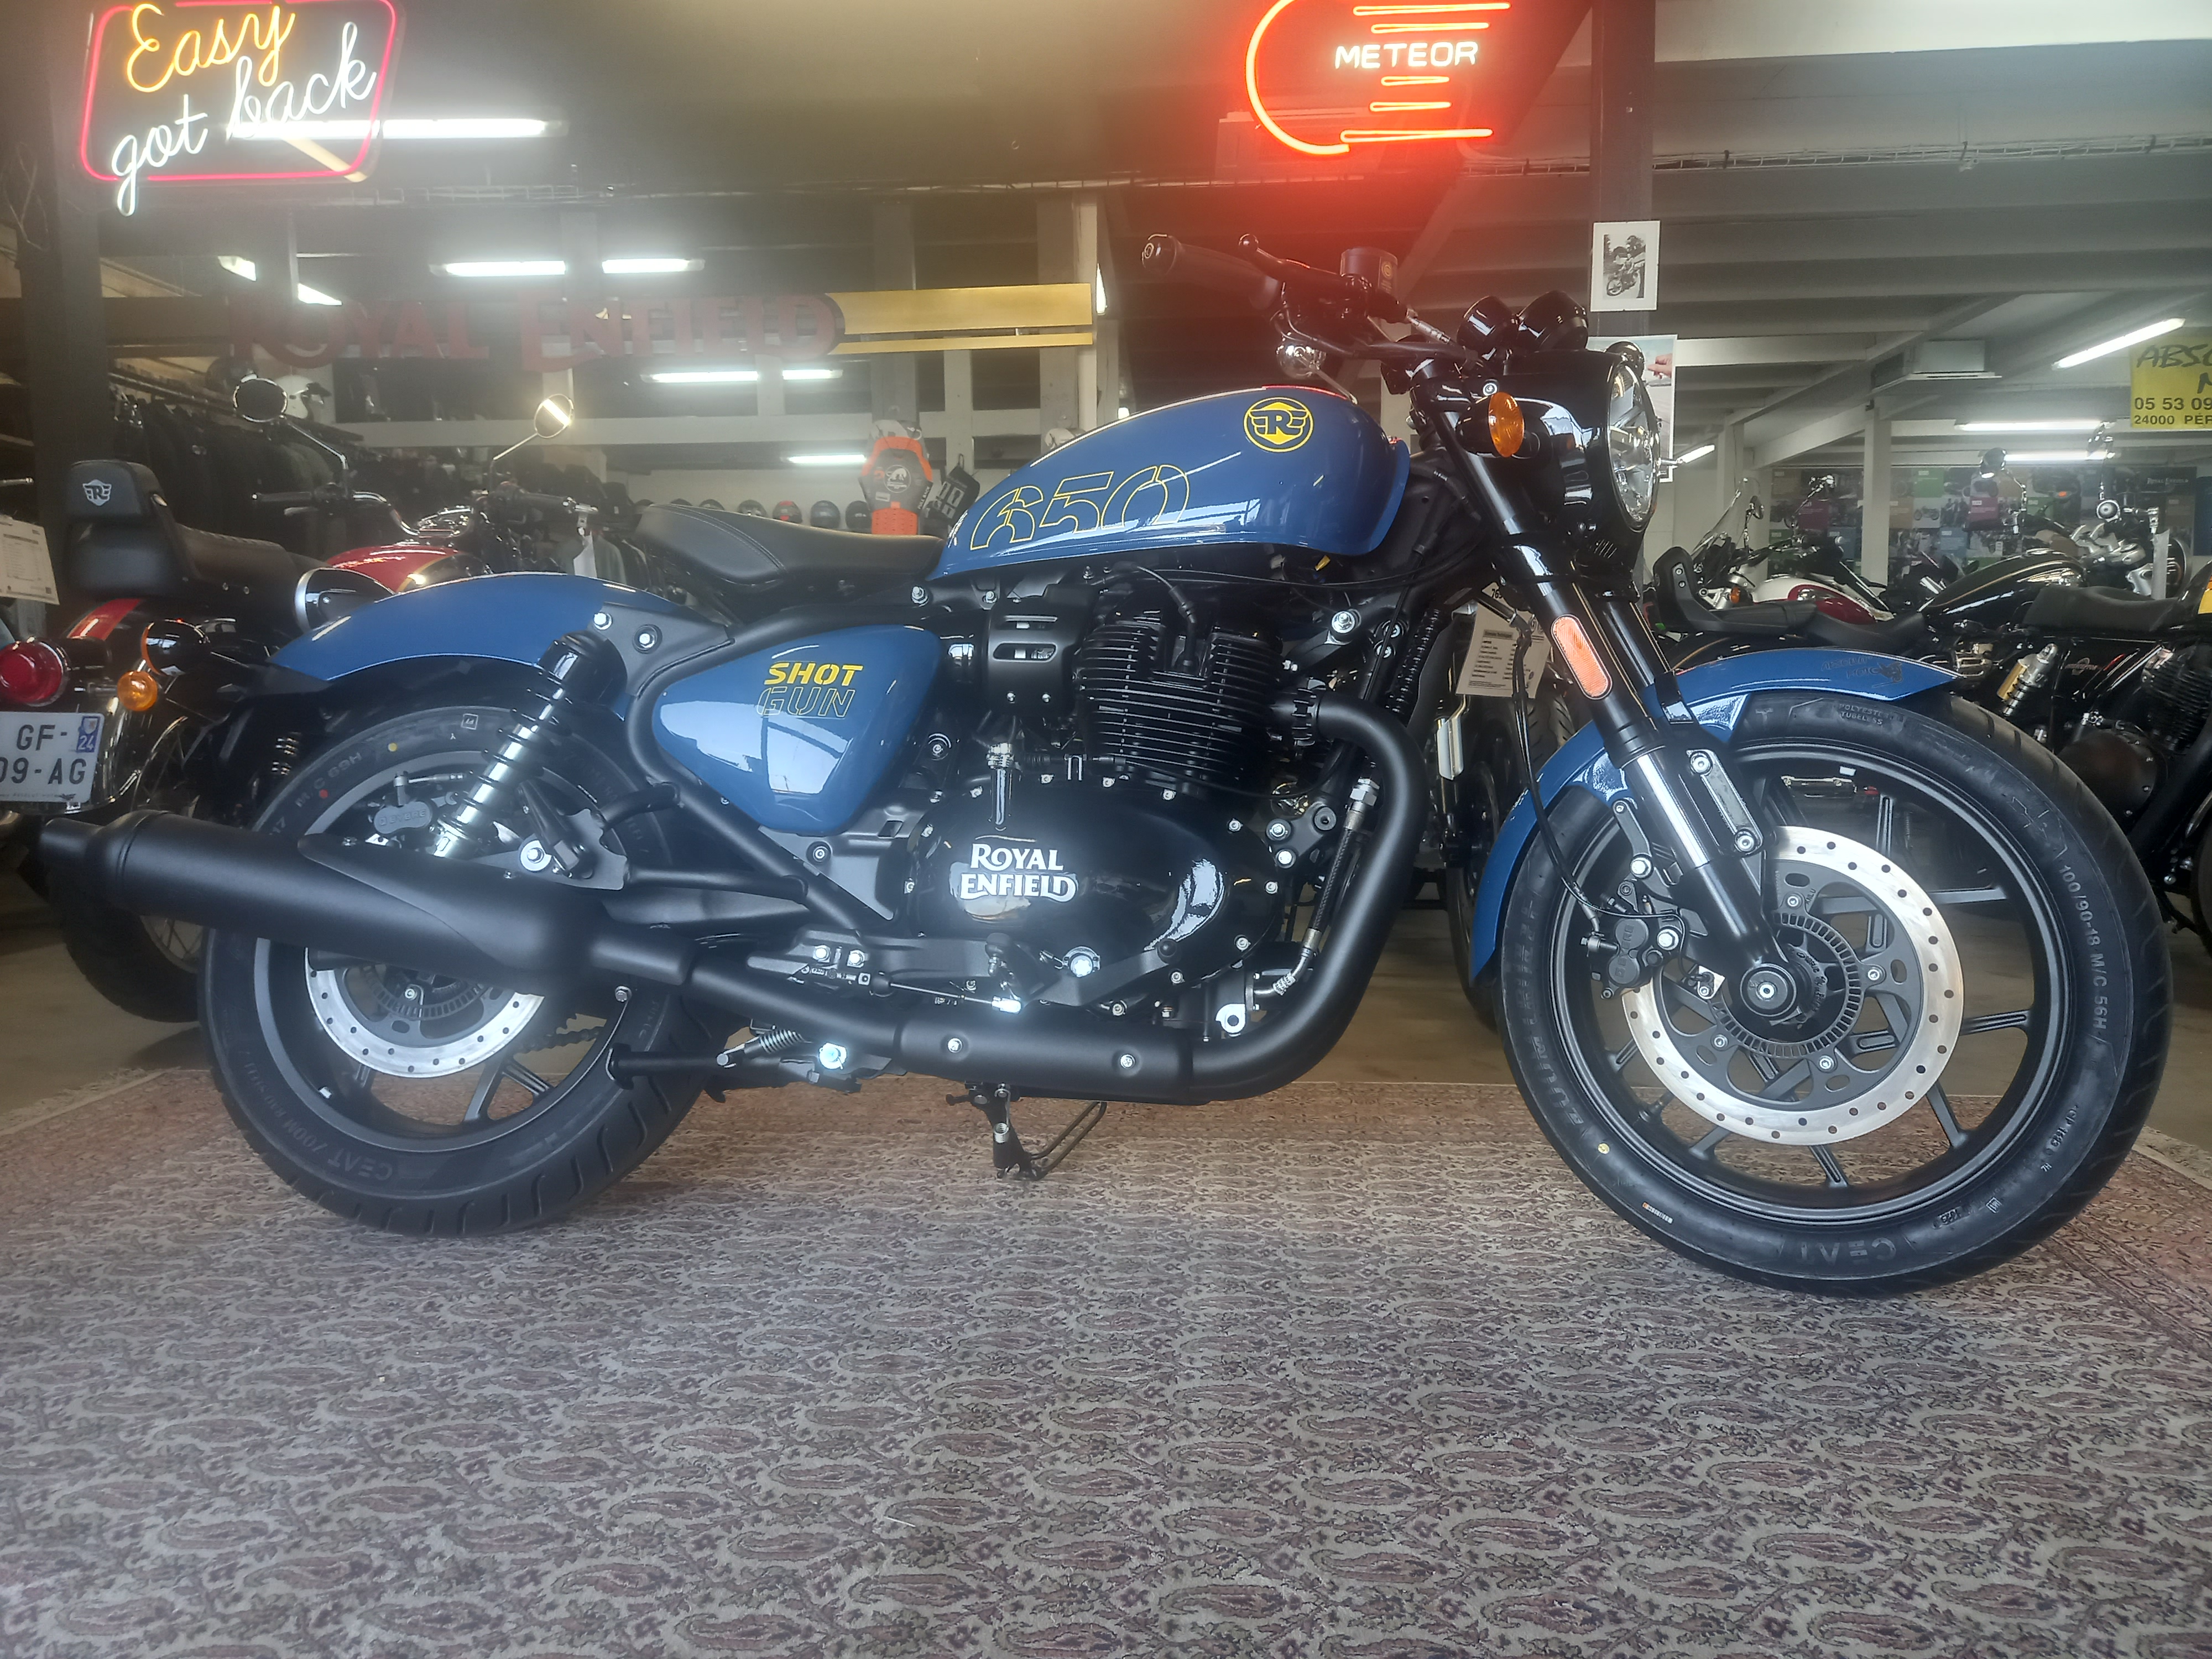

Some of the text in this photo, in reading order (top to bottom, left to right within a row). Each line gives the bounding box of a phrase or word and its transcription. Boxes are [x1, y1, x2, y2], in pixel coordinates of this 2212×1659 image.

[126, 3, 295, 93] Easy
[1334, 41, 1479, 69] METEOR
[110, 21, 378, 217] got back
[2134, 397, 2155, 410] 05
[2162, 397, 2184, 411] 53
[2134, 415, 2175, 425] 24000
[969, 465, 1191, 550] 650
[764, 662, 863, 686] SHOT
[757, 686, 855, 718] GUN
[1840, 711, 1884, 726] TUBELESS
[77, 735, 95, 750] 24
[970, 843, 1064, 872] ROYAL
[960, 873, 1077, 903] ENFIELD
[2058, 864, 2109, 1030] 100/90-18 M/C 56H
[327, 1147, 394, 1181] CEAT
[1798, 1237, 1898, 1264] CEAT
